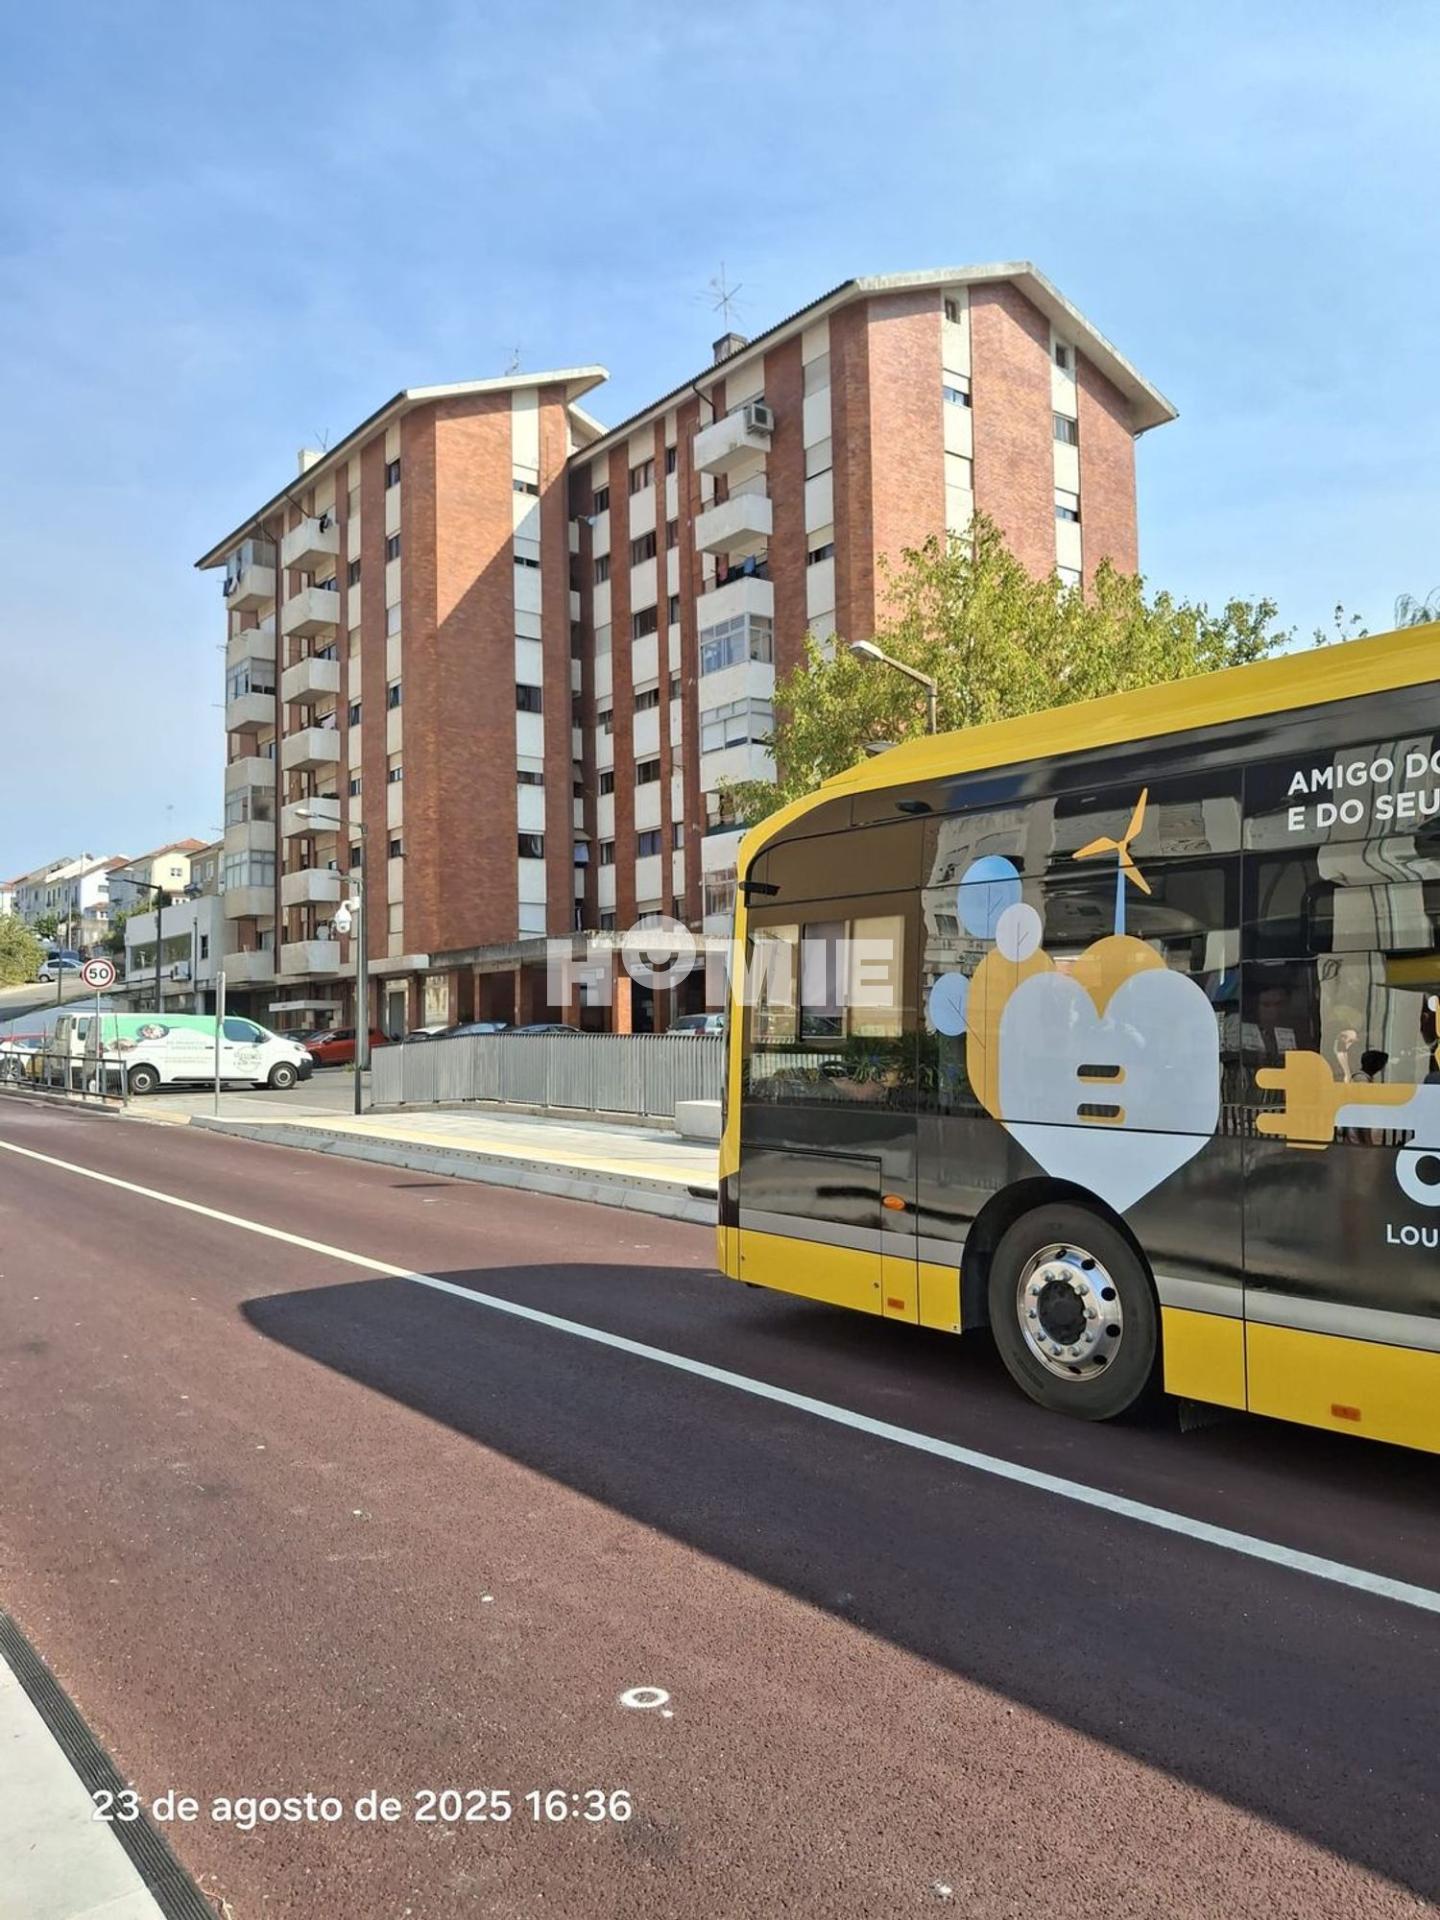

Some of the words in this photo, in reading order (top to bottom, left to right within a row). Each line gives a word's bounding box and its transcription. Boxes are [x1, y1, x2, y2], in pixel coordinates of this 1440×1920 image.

[1287, 757, 1395, 796] AMIGO
[1287, 806, 1306, 832] E
[1316, 798, 1365, 828] DO
[1374, 787, 1440, 821] SEU
[89, 967, 109, 980] 50
[1386, 1223, 1439, 1248] LOU
